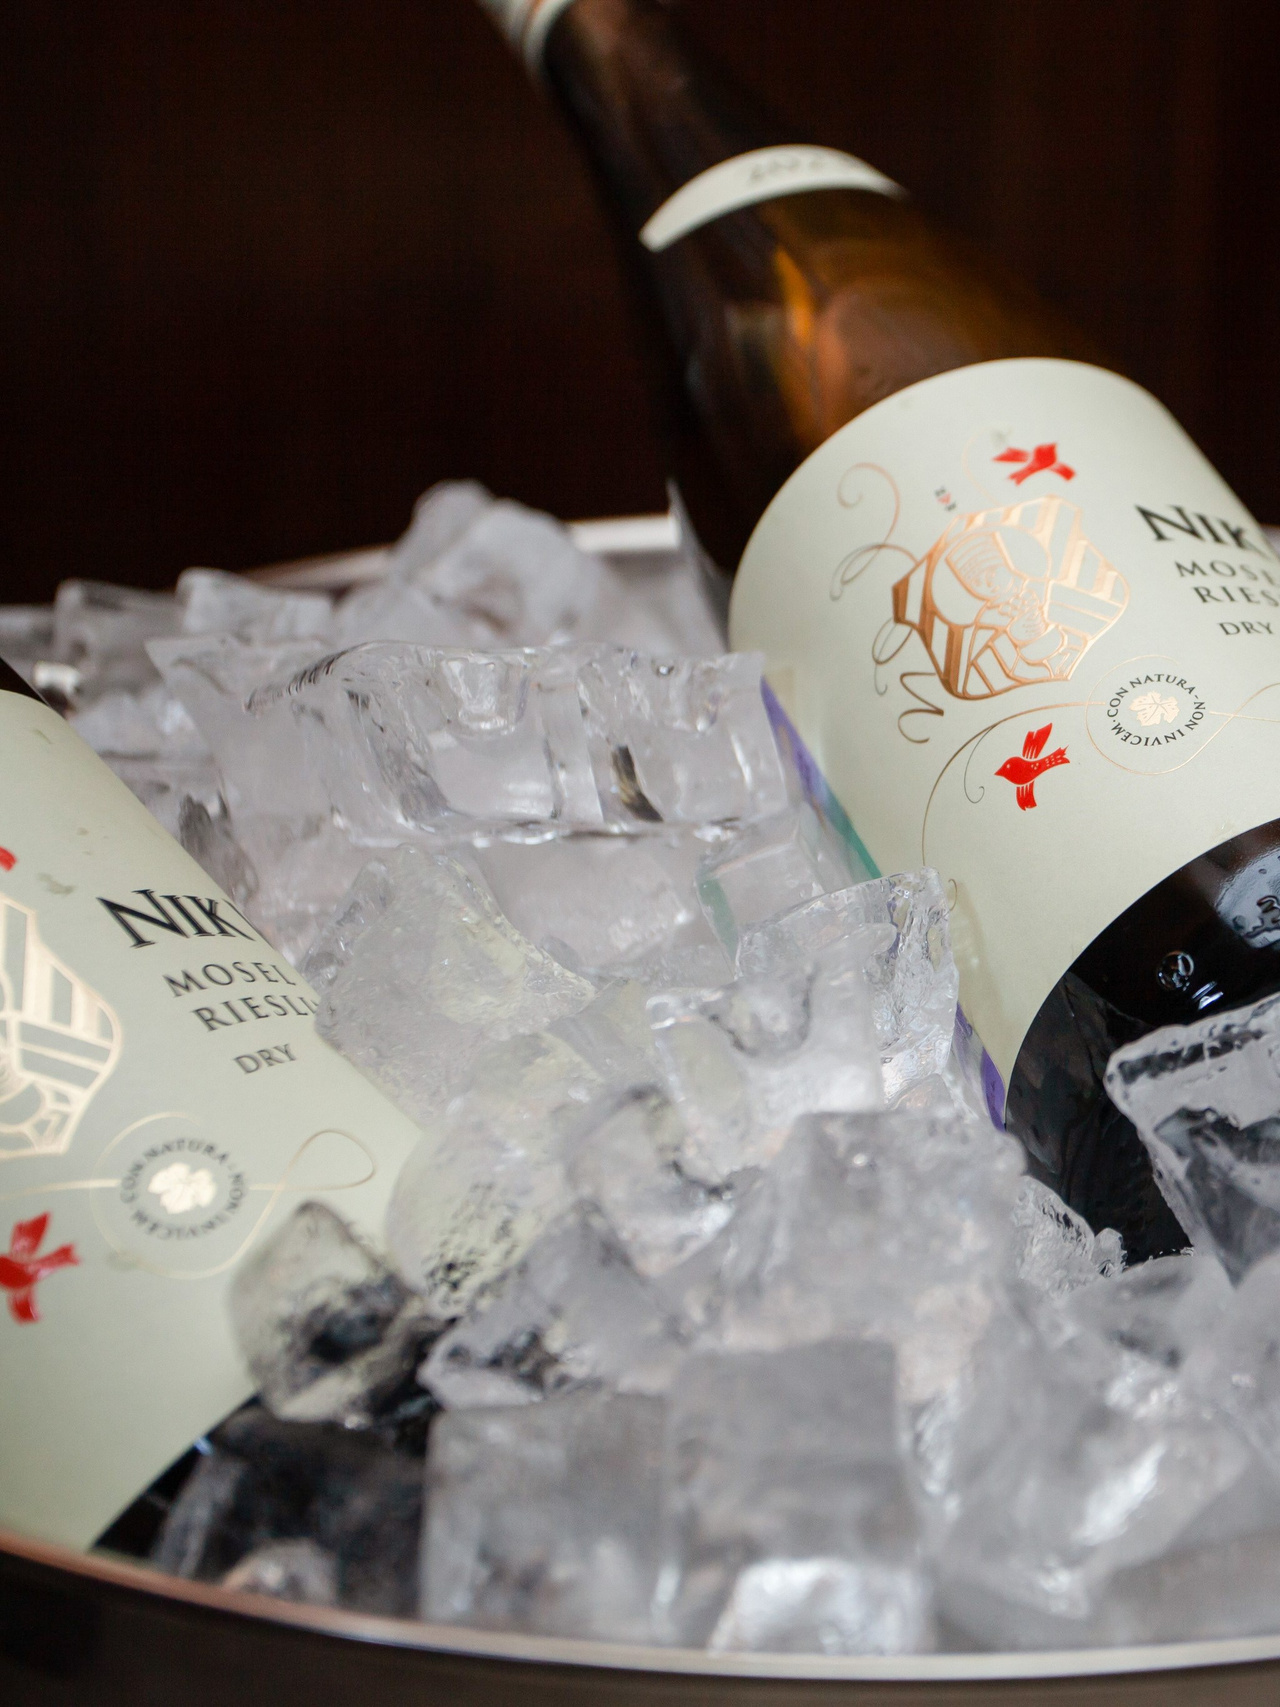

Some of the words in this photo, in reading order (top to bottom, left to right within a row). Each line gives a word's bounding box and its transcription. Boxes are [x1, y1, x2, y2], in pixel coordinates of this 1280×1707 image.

[1217, 620, 1275, 636] DRY
[1129, 673, 1196, 695] NATURA
[1106, 686, 1129, 718] CON
[1184, 701, 1206, 731] NON
[1110, 722, 1186, 747] INVICEM
[162, 960, 297, 998] MOSEL
[233, 1043, 297, 1075] DRY
